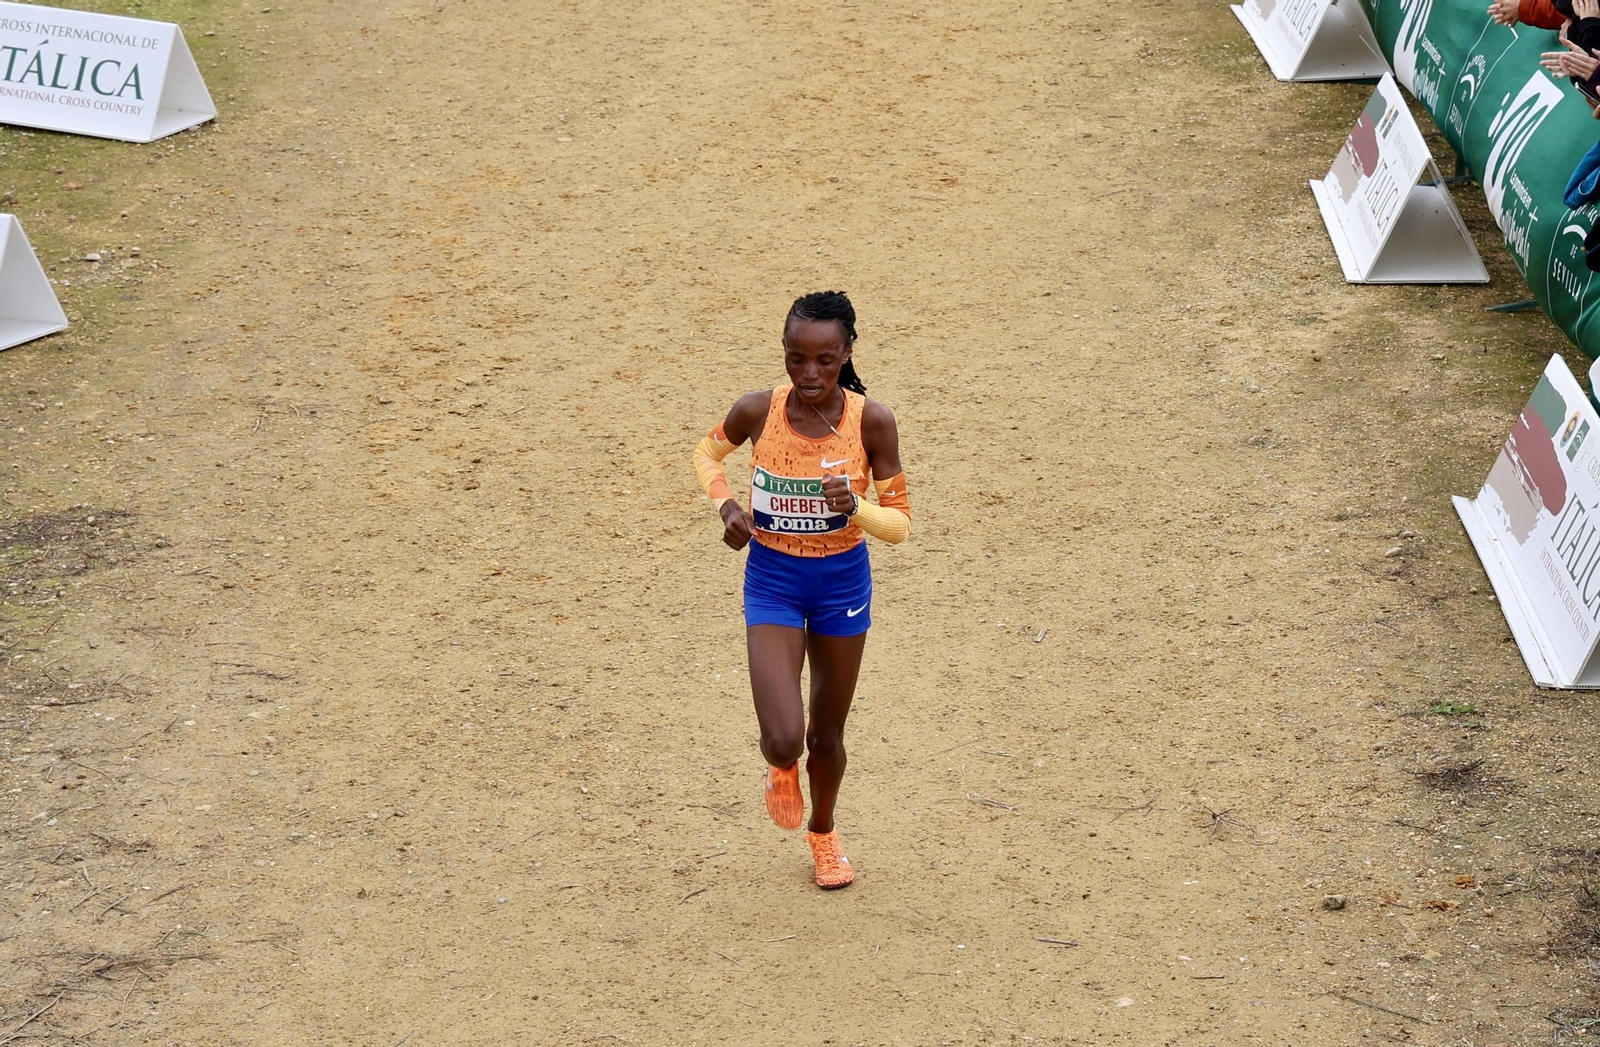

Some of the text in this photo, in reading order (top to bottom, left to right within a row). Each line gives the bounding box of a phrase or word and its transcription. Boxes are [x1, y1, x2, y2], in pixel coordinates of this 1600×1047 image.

[0, 17, 158, 50] ROSS INTERNACIONAL DE
[1282, 0, 1318, 42] LICA
[0, 39, 145, 101] TÁLICA
[58, 95, 91, 109] CROSS
[93, 100, 144, 116] COUNTRY
[1552, 257, 1582, 301] SEVILLA
[770, 496, 827, 514] CHEBET
